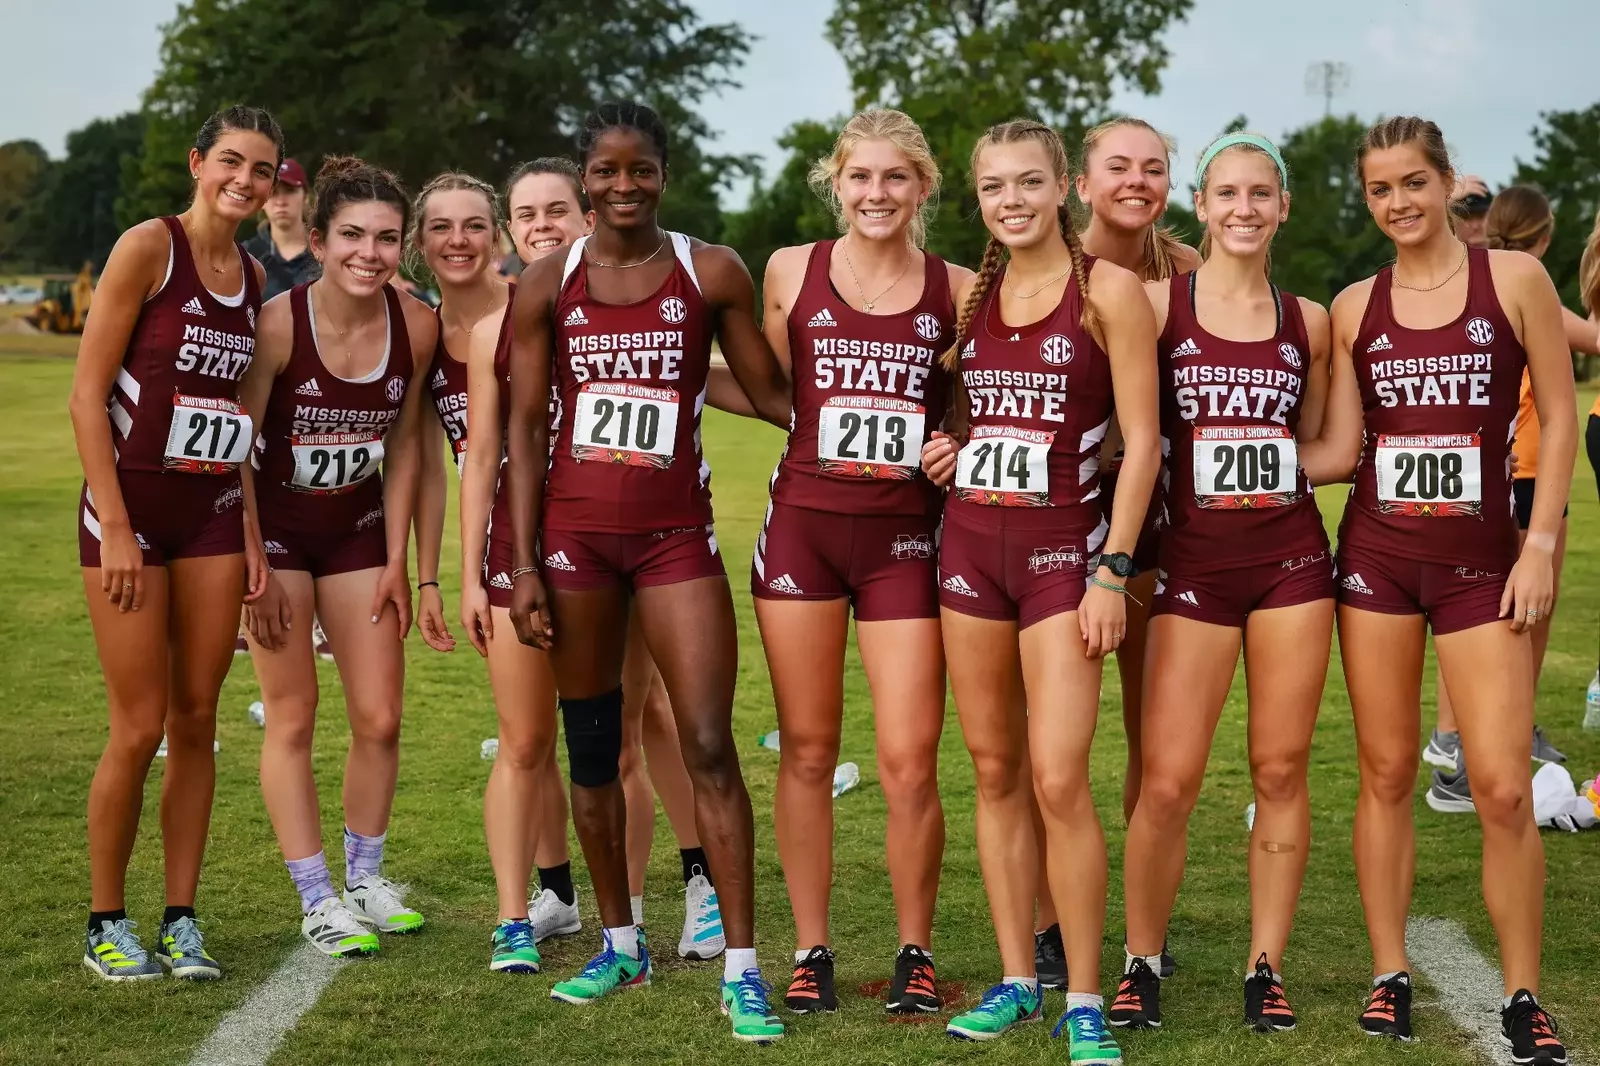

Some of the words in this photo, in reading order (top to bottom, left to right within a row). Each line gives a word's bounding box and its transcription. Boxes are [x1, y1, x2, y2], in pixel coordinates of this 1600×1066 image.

[181, 306, 206, 317] adidas
[564, 317, 589, 326] adidas
[661, 298, 685, 323] SEC
[808, 319, 837, 328] adidas
[915, 315, 940, 340] SEC
[1467, 319, 1493, 344] SEC
[568, 331, 683, 353] MISSISSIPPI
[813, 338, 934, 366] MISSISSIPPI
[1042, 336, 1072, 364] SEC
[1366, 342, 1393, 353] adidas
[175, 343, 253, 381] STAT
[1170, 348, 1201, 359] adidas
[570, 350, 683, 383] STATE
[1370, 353, 1492, 380] MISSISSIPPI
[815, 357, 930, 399] STATE
[1173, 365, 1301, 395] MISSISSIPPI
[295, 388, 322, 397] adidas
[387, 378, 404, 401] SEC
[588, 383, 626, 395] SOUTHERN
[627, 385, 672, 401] SHOWCASE
[1375, 373, 1491, 408] STATE
[179, 396, 217, 409] SOUTHERN
[294, 404, 399, 423] MISSISSIPPI
[829, 396, 872, 409] SOUTHERN
[874, 398, 918, 412] SHOWCASE
[968, 387, 1066, 423] STATE
[1175, 385, 1297, 426] STATE
[183, 412, 241, 459] 217
[590, 399, 660, 451] 210
[1004, 427, 1047, 443] SHOWCASE
[1201, 427, 1245, 439] SOUTHERN
[1246, 427, 1285, 439] SHOWCASE
[299, 434, 339, 445] SOUTHERN
[340, 432, 374, 444] SHOWCASE
[837, 412, 907, 463] 213
[1385, 436, 1426, 447] SOUTHERN
[1427, 435, 1472, 447] SHOWCASE
[310, 447, 371, 487] 212
[970, 442, 1031, 489] 214
[1213, 443, 1280, 492] 209
[1394, 453, 1463, 500] 208
[899, 541, 926, 551] STATE
[545, 558, 576, 572] adidas
[1037, 553, 1074, 564] STATE
[769, 582, 804, 595] adidas
[943, 582, 979, 598] adidas
[1341, 581, 1373, 595] adidas
